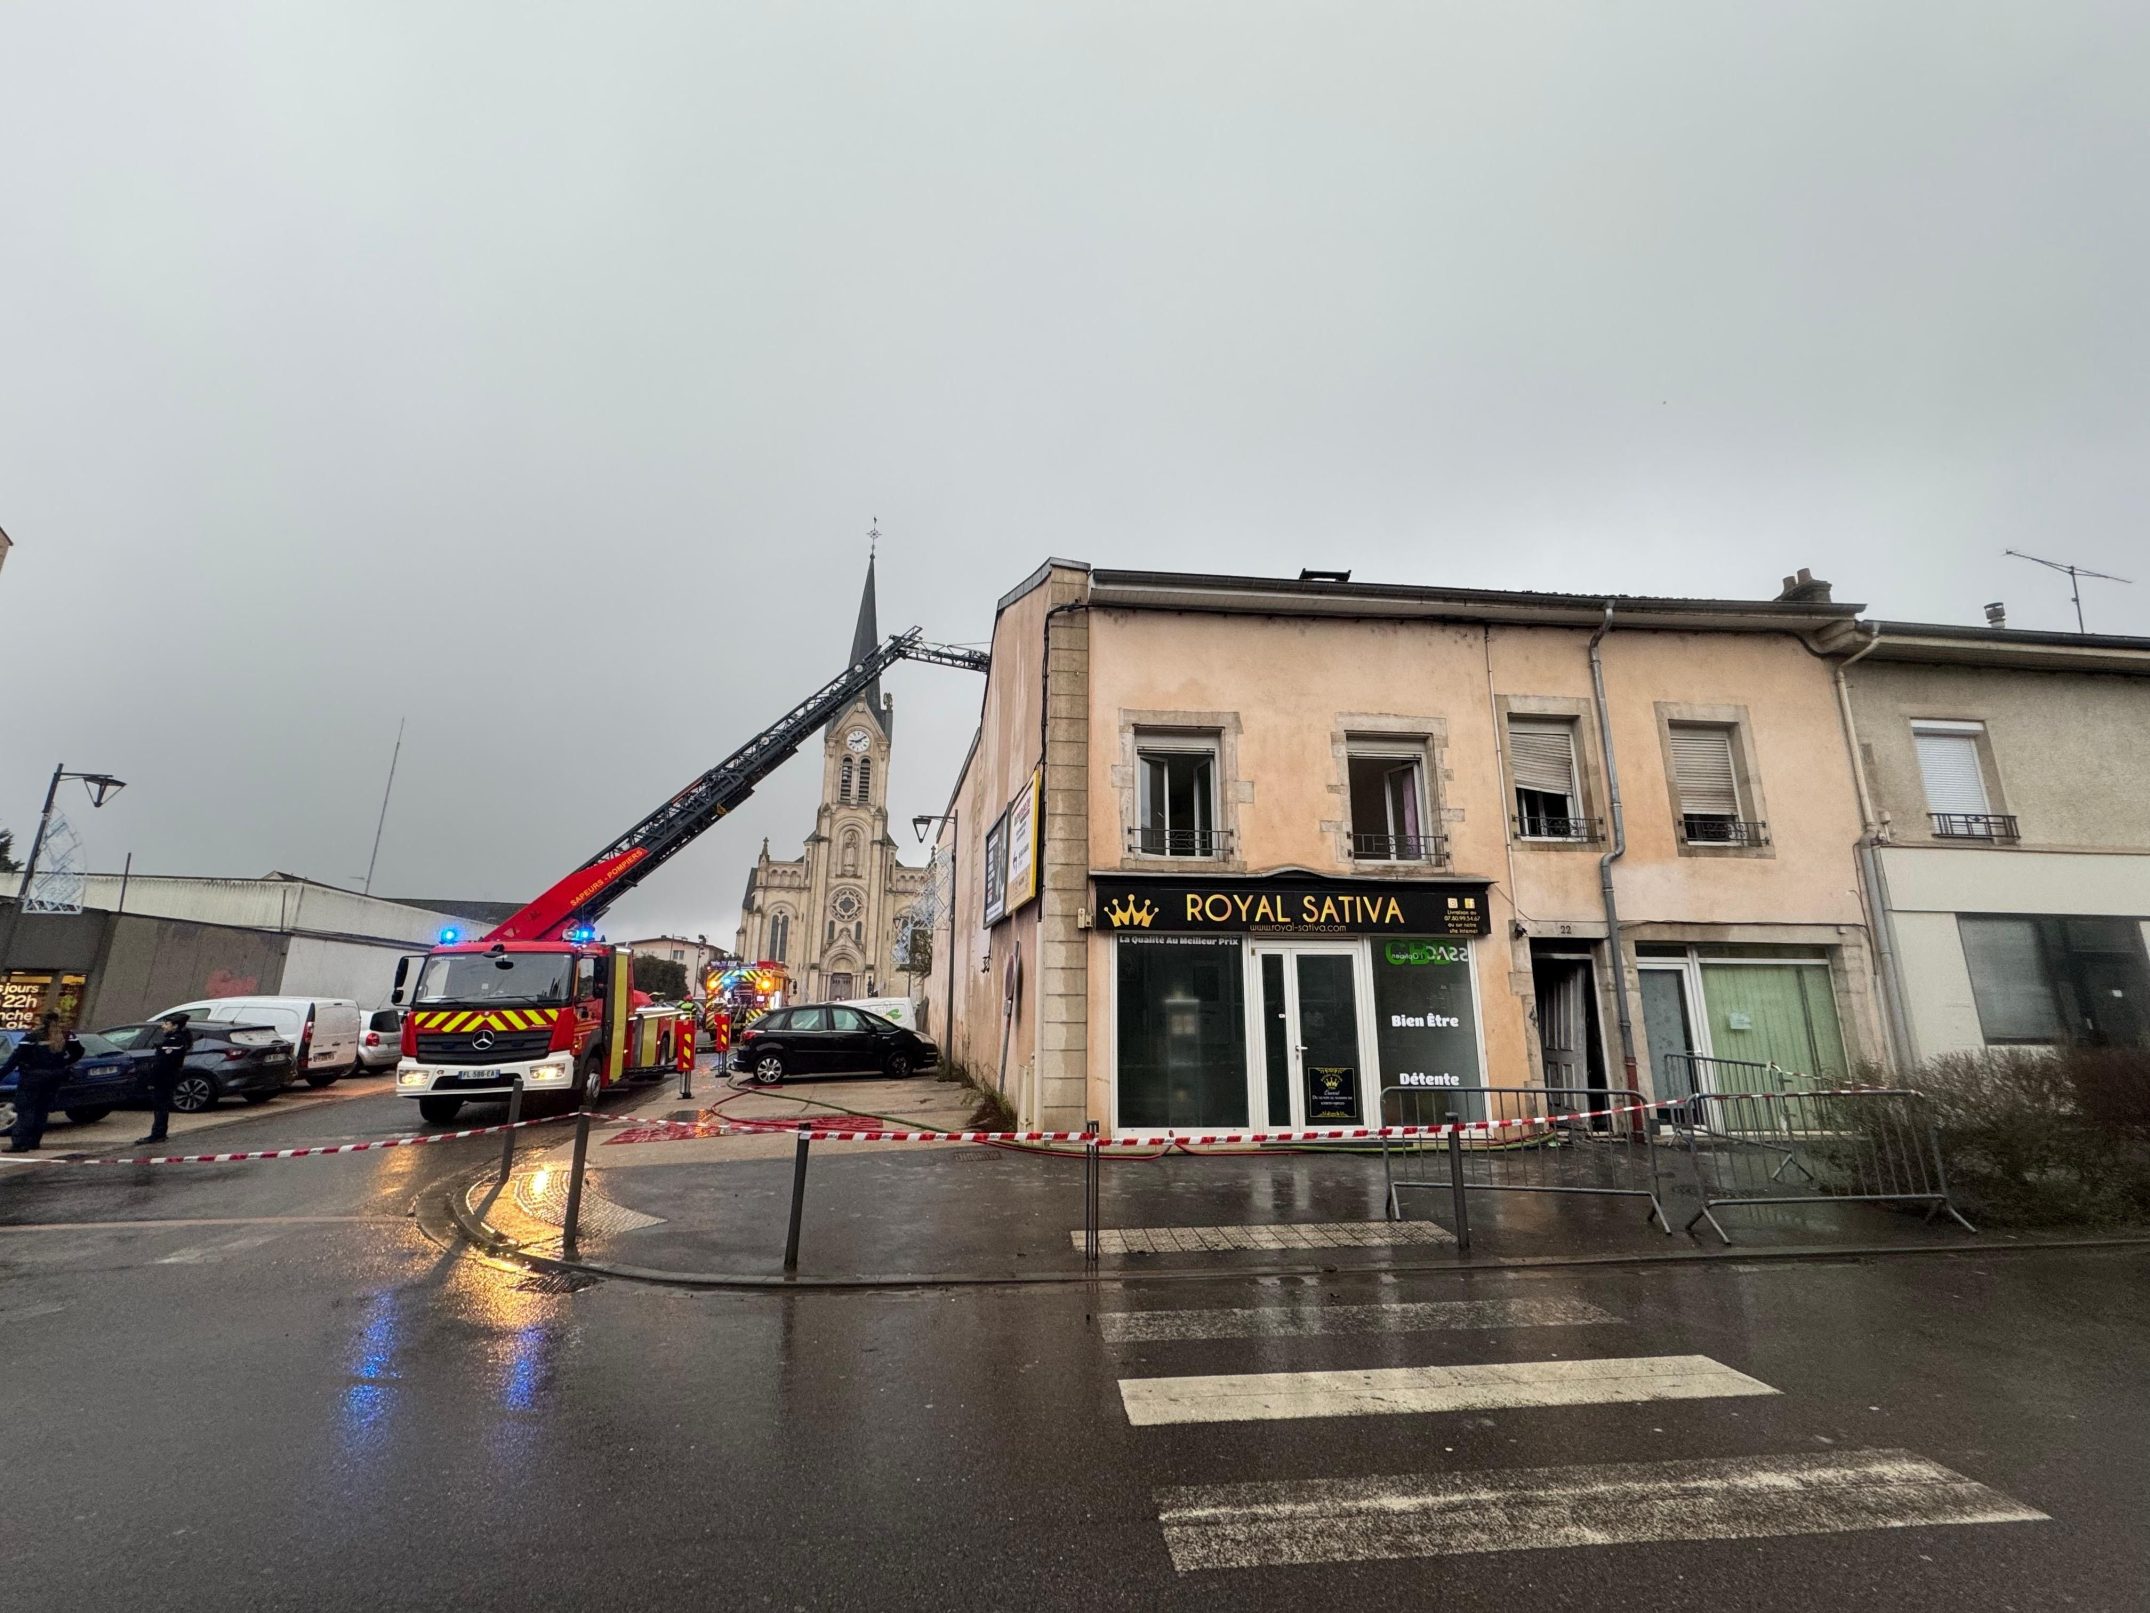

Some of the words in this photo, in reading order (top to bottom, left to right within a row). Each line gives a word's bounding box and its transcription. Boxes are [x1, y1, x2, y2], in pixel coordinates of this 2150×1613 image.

[569, 878, 604, 906] SAPEURS
[606, 849, 643, 879] POMPIERS
[1186, 893, 1291, 923] ROYAL
[1302, 895, 1404, 924] SATIVA
[1250, 922, 1346, 932] www.royal-sativa.com
[1560, 925, 1572, 934] 22
[1131, 936, 1164, 944] Qualité
[1179, 937, 1217, 945] Meilleur
[1218, 938, 1239, 946] Prix
[2, 983, 39, 995] jours
[2, 995, 38, 1008] 22h
[1391, 1013, 1424, 1027] Bien
[1426, 1012, 1459, 1027] Être
[1399, 1072, 1460, 1086] Détente
